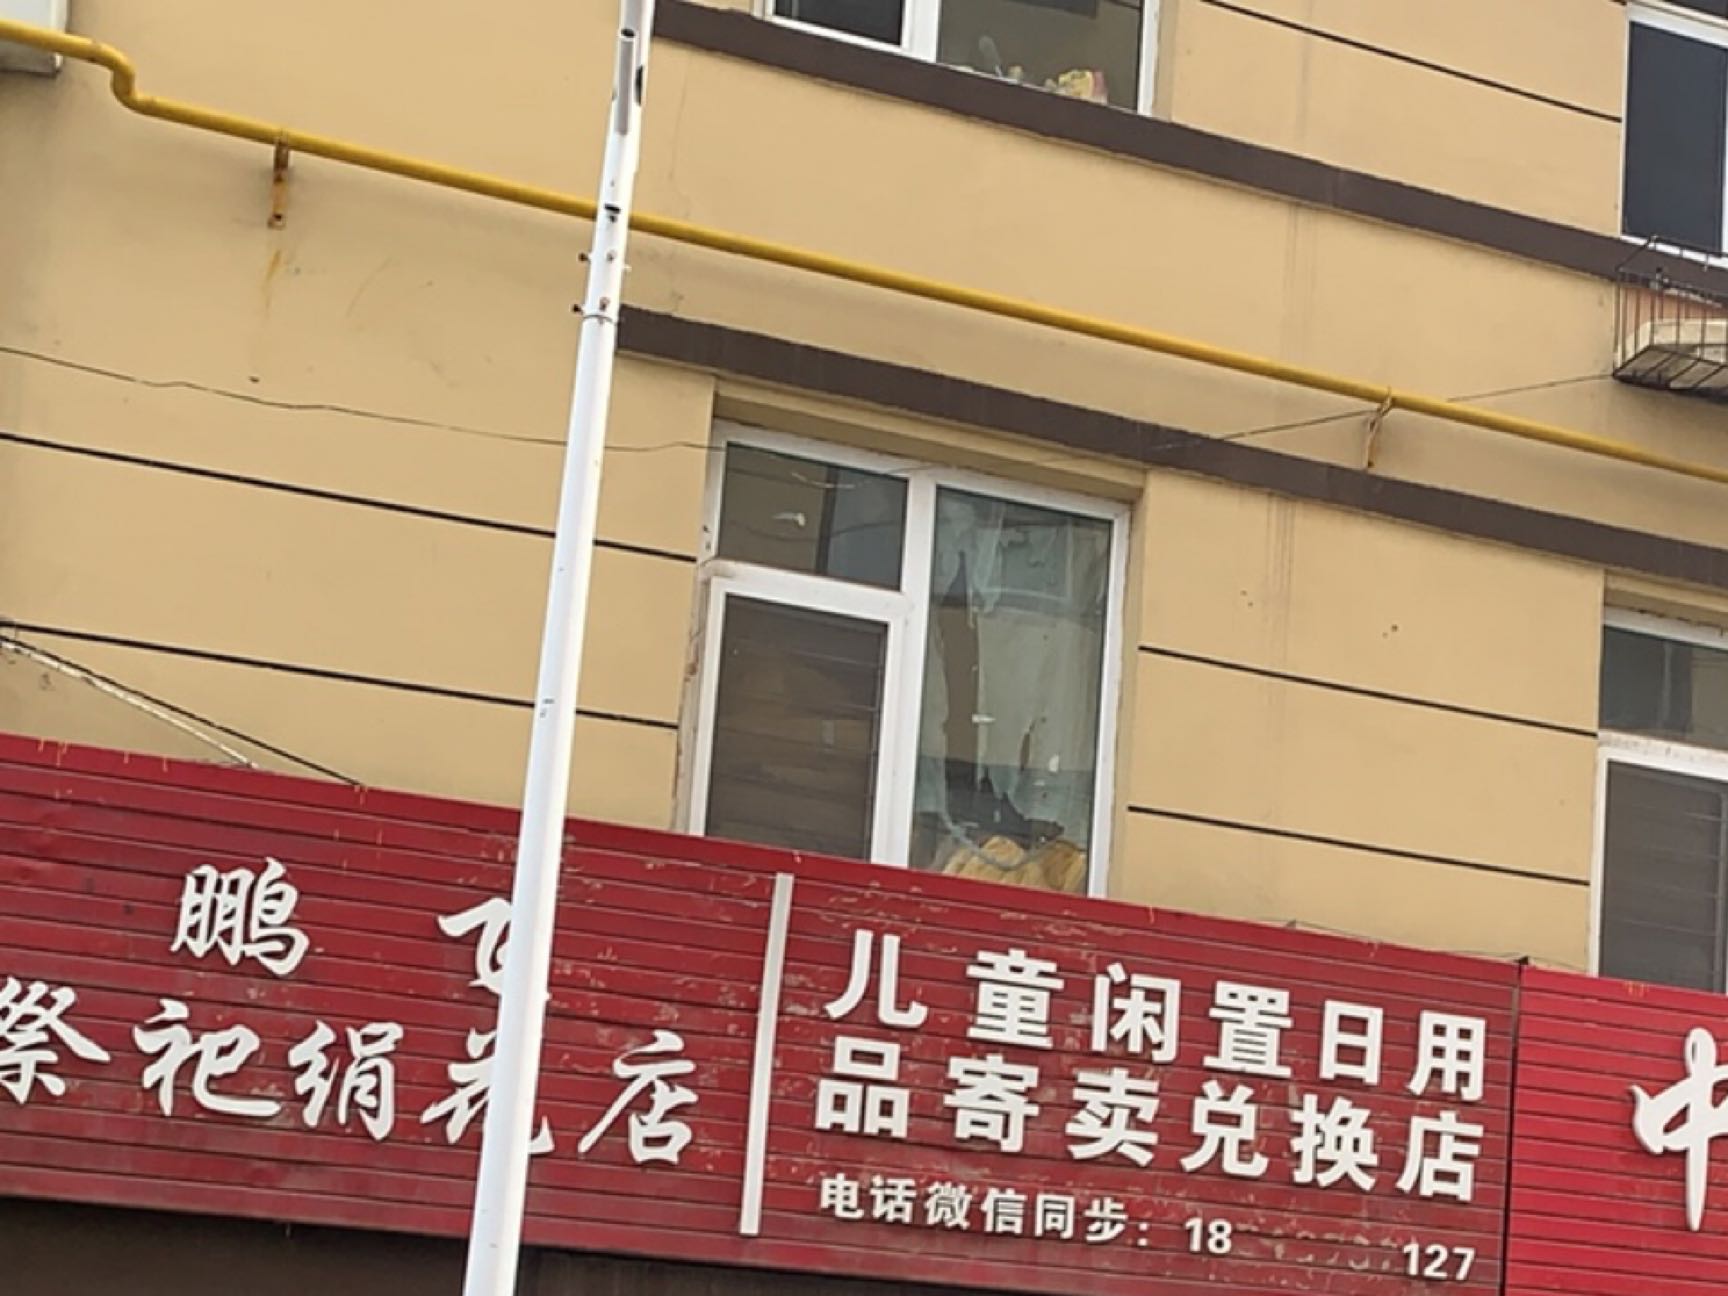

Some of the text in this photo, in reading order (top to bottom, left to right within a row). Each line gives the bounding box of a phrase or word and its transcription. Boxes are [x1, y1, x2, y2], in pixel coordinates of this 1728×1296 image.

[825, 929, 1487, 1101] 儿童闲置日用
[814, 1035, 1484, 1203] 品寄卖兑换店
